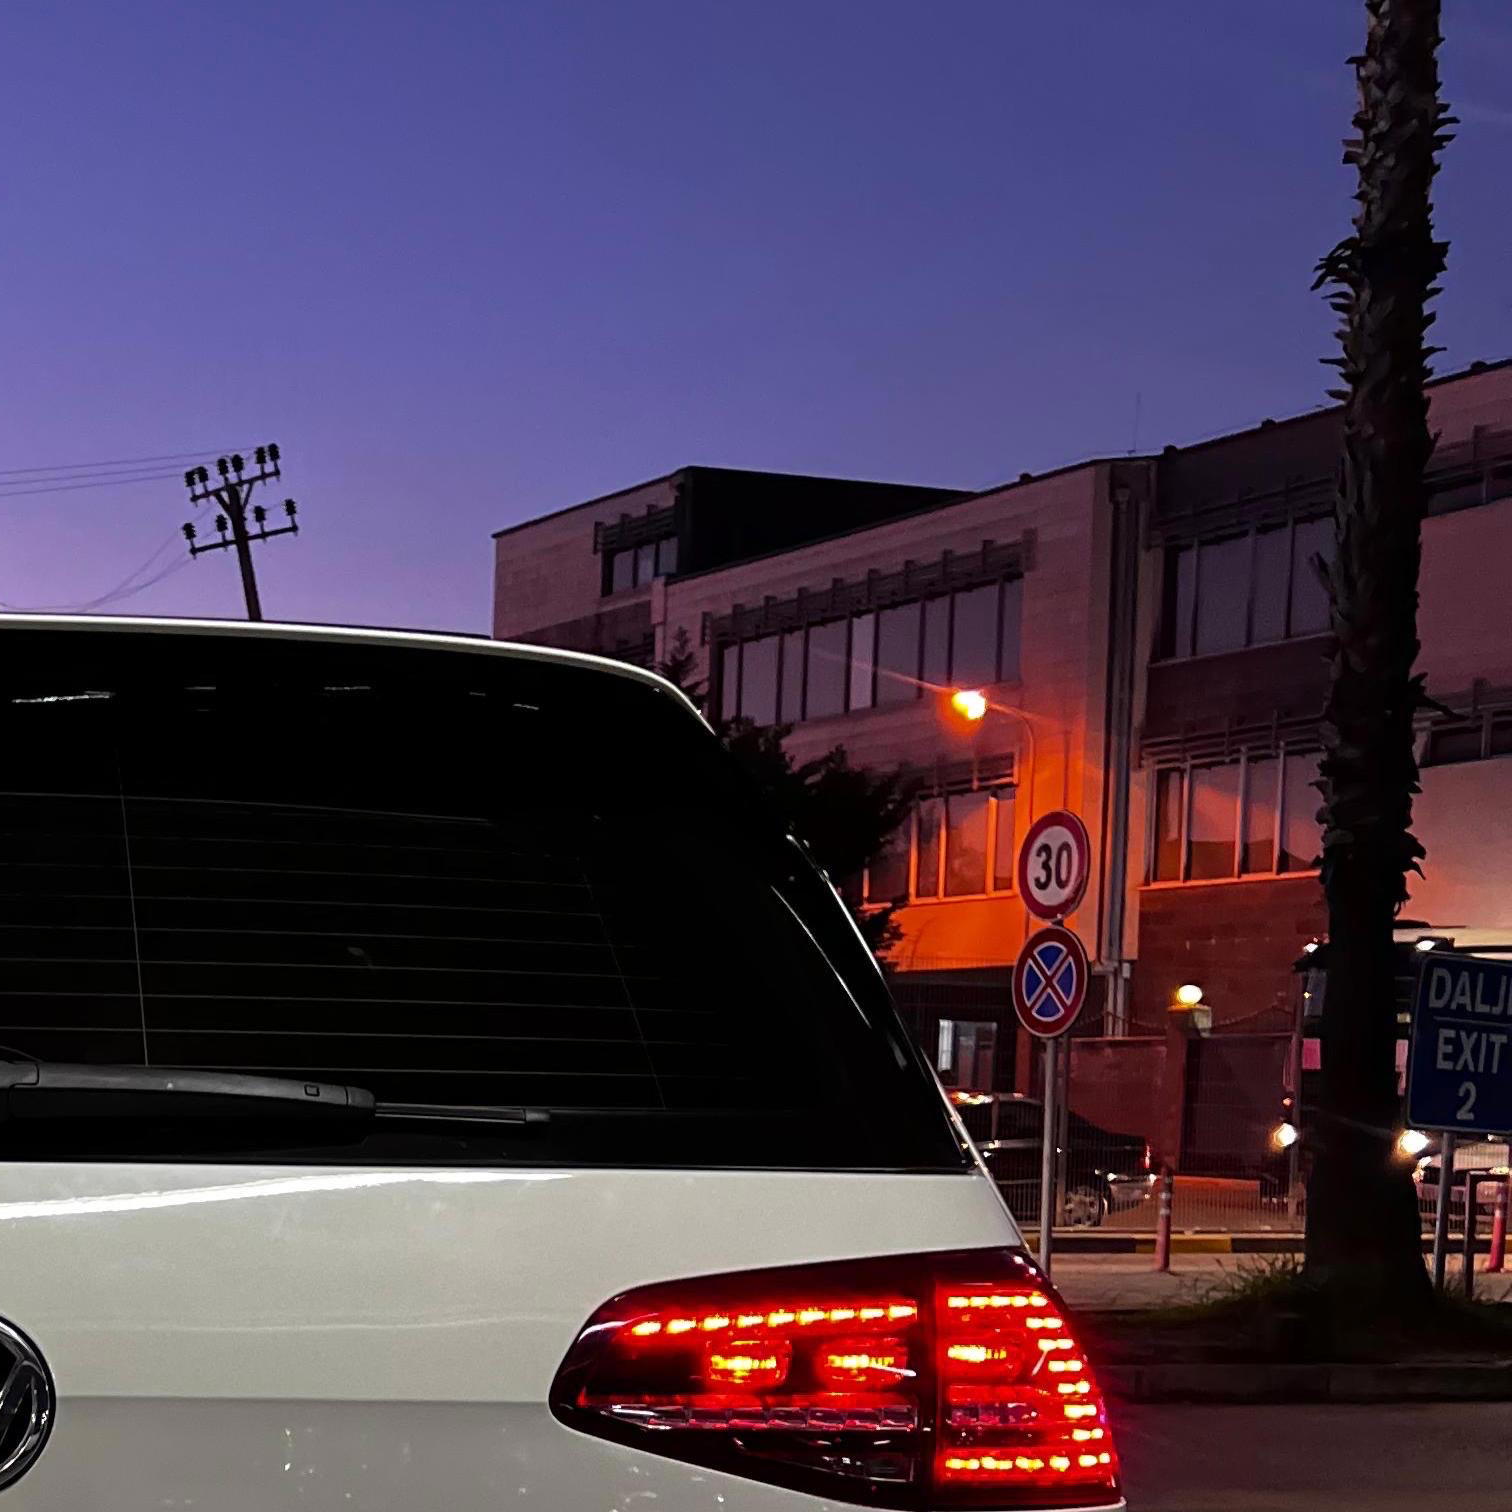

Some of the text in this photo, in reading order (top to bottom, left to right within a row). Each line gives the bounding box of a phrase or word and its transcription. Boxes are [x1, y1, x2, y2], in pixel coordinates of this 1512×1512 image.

[1034, 841, 1073, 890] 30
[1436, 1027, 1508, 1075] EXIT
[1456, 1081, 1477, 1121] 2
